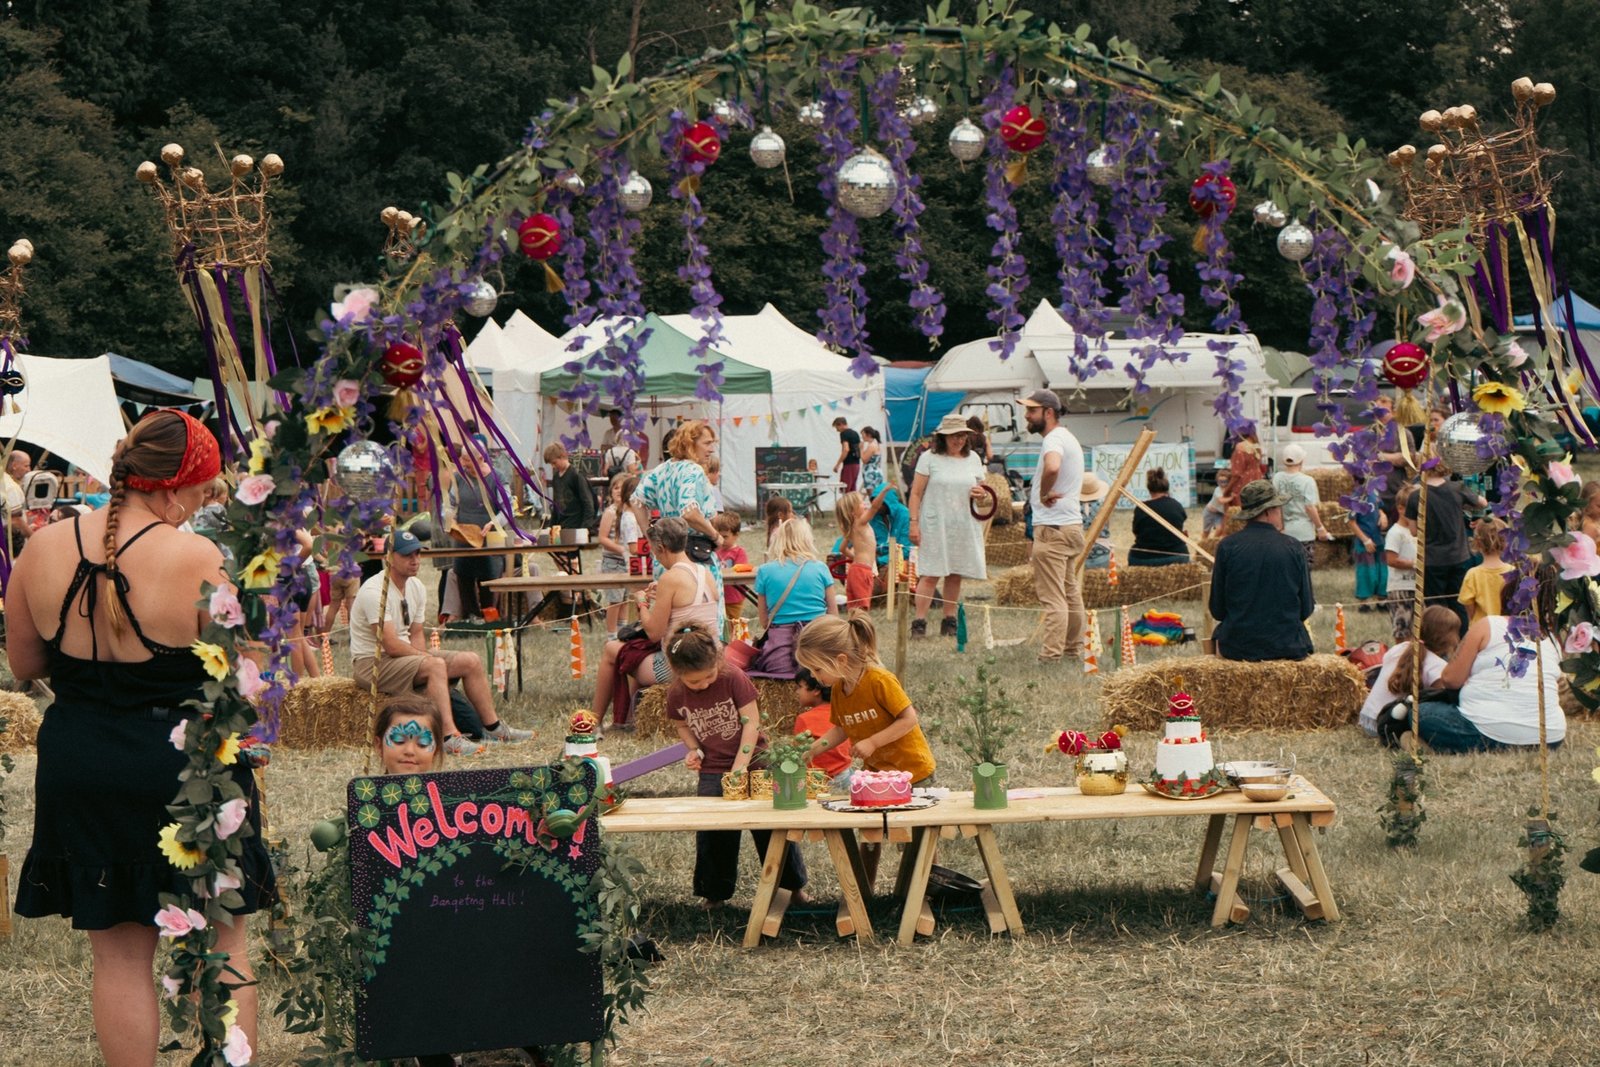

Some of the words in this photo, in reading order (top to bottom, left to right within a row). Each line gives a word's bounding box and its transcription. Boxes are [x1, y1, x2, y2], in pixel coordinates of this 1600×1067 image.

[1096, 452, 1183, 470] REGATION
[687, 714, 725, 733] Wood
[453, 873, 465, 888] to
[474, 873, 495, 888] the
